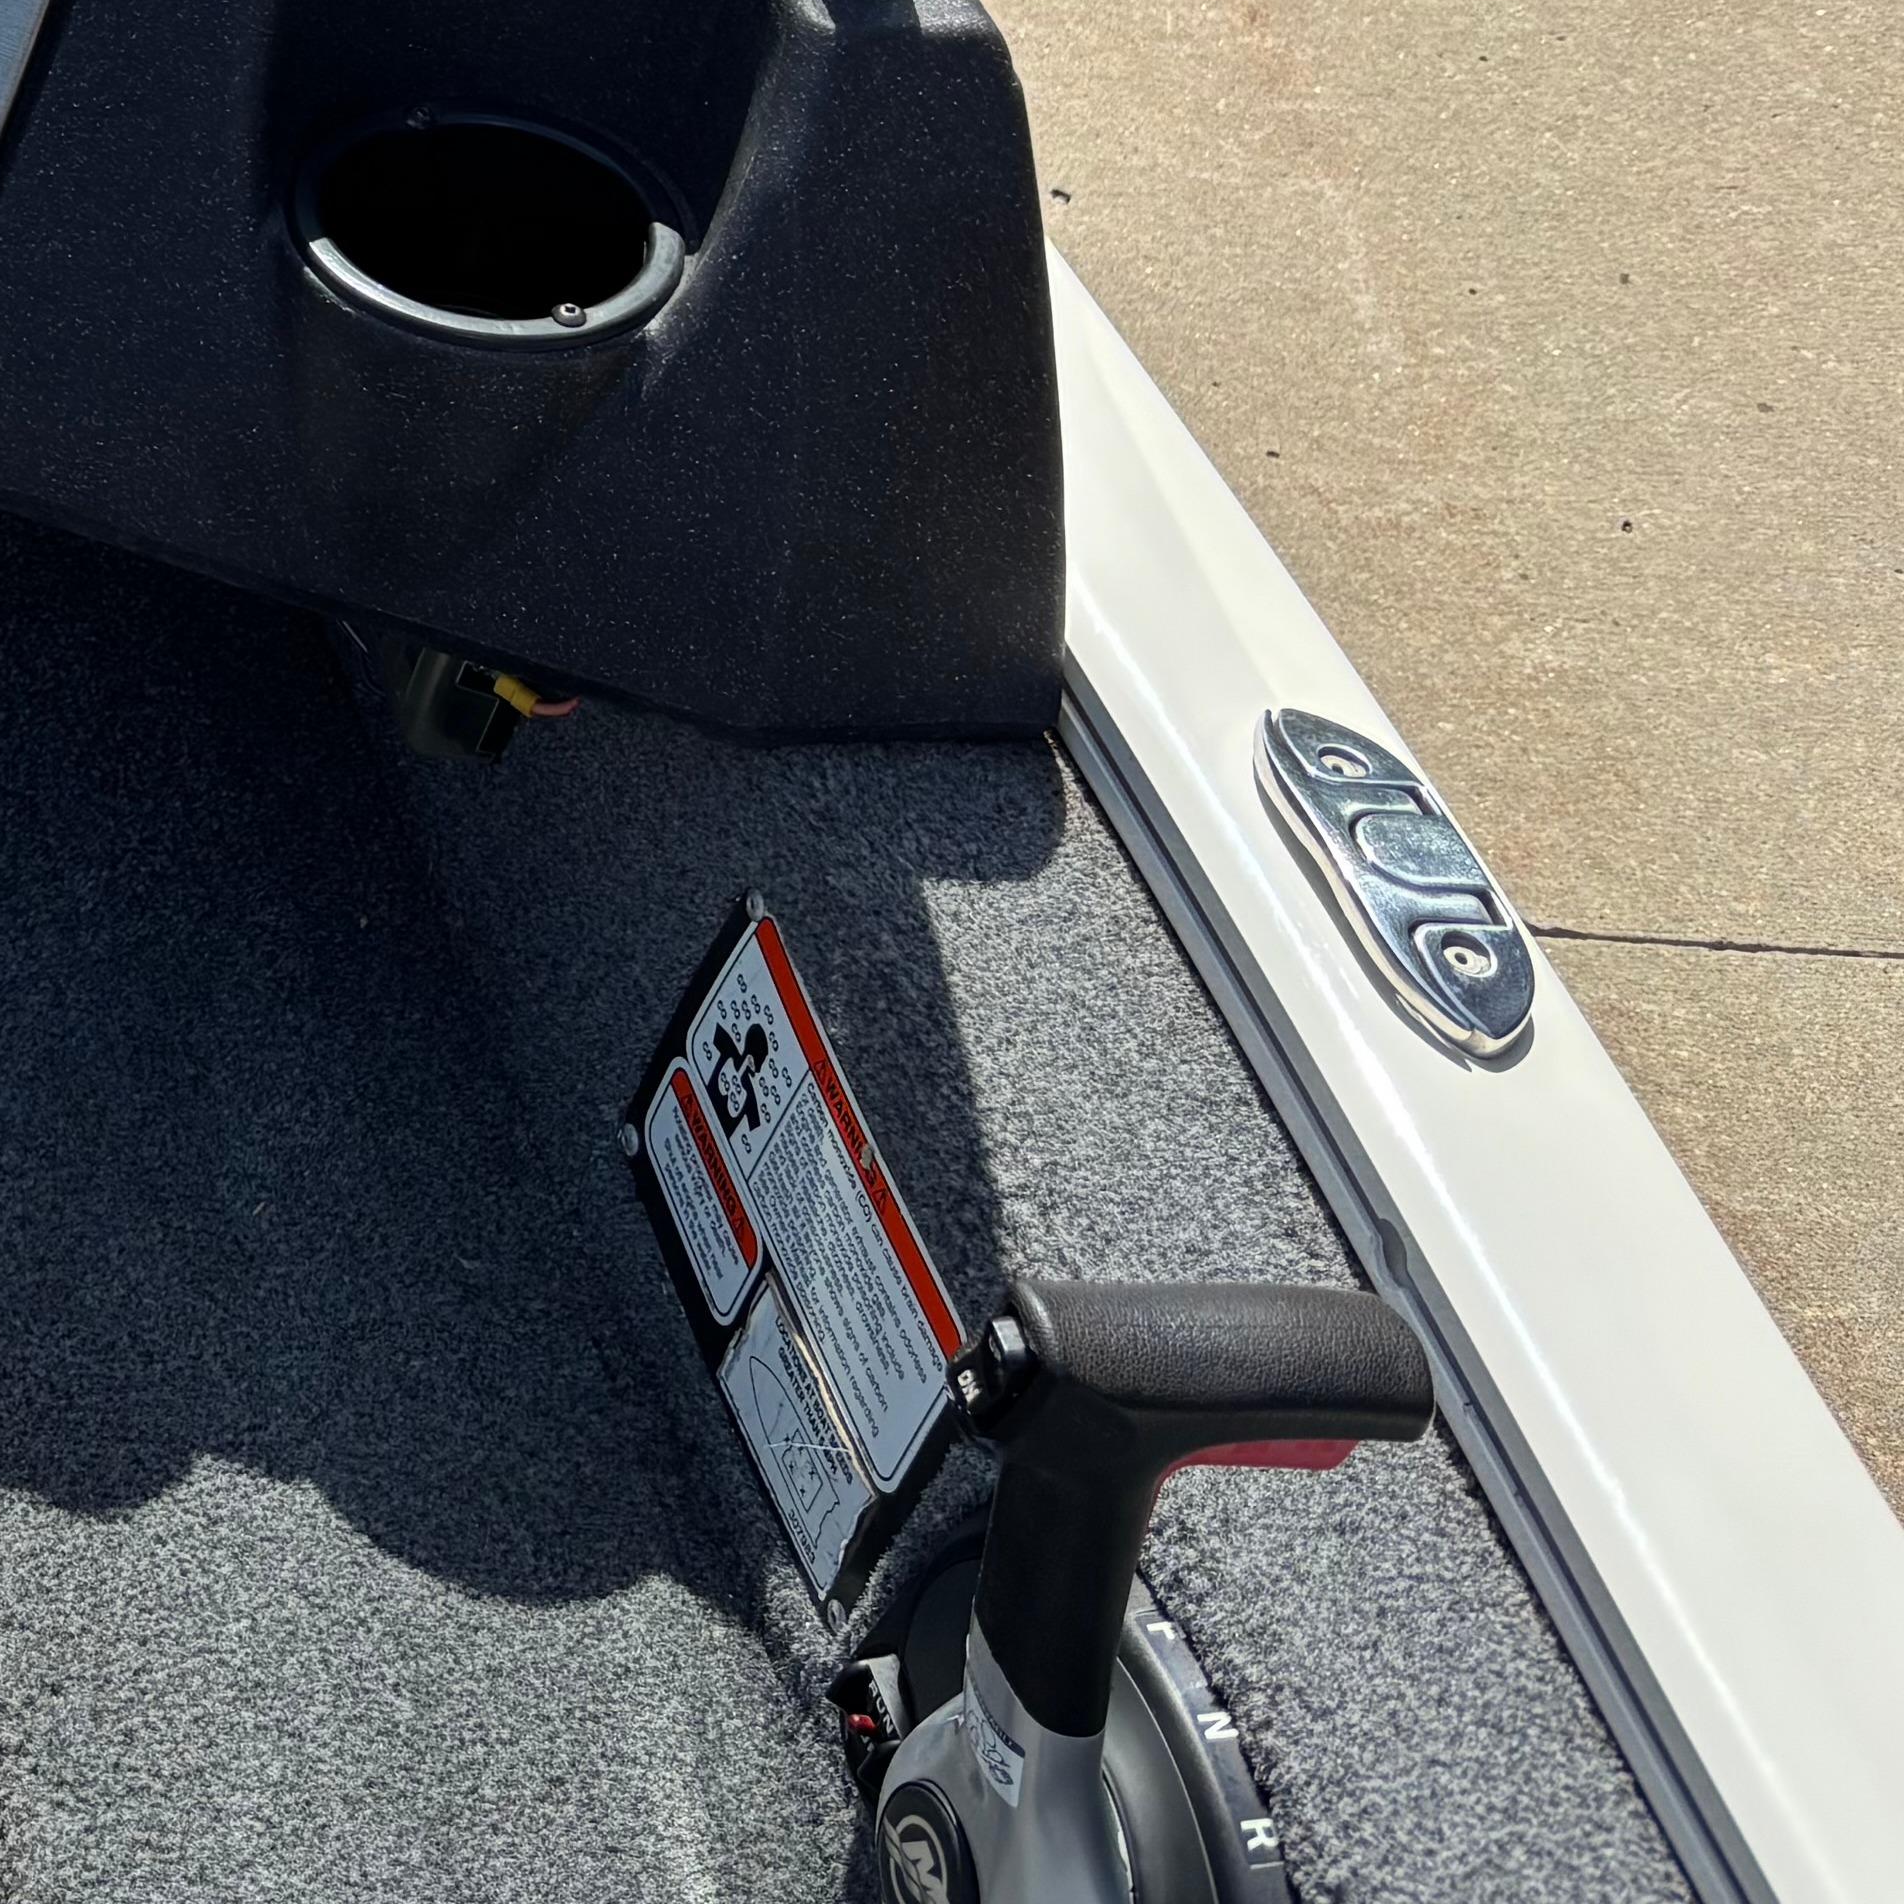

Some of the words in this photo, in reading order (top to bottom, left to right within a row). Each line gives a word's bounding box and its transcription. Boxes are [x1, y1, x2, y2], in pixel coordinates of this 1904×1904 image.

[736, 973, 747, 993] CO
[716, 999, 727, 1020] CO
[729, 999, 740, 1020] CO
[740, 999, 751, 1021] CO
[750, 994, 761, 1014] CO
[763, 1004, 774, 1025] CO
[731, 1022, 741, 1043] CO
[768, 1031, 779, 1052] CO
[702, 1041, 712, 1061] CO
[768, 1057, 779, 1079] CO
[781, 1066, 792, 1088] CO
[720, 1071, 730, 1092] CO
[731, 1074, 741, 1095] CO
[758, 1076, 769, 1097] CO
[727, 1091, 740, 1112] CO
[770, 1085, 781, 1106] CO
[760, 1102, 771, 1124] CO
[740, 1133, 751, 1154] CO
[689, 1112, 736, 1216] WARNING
[854, 1190, 872, 1223] (CO)
[871, 1223, 883, 1247] can
[900, 1285, 918, 1319] brain
[775, 1313, 807, 1383] LOCATIONS
[804, 1383, 815, 1400] AT
[812, 1398, 831, 1434] BOAT
[778, 1346, 804, 1402] GREATER
[803, 1401, 820, 1437] THAN
[869, 1680, 893, 1733] RUN
[1196, 1711, 1239, 1739] N
[1240, 1818, 1279, 1851] R
